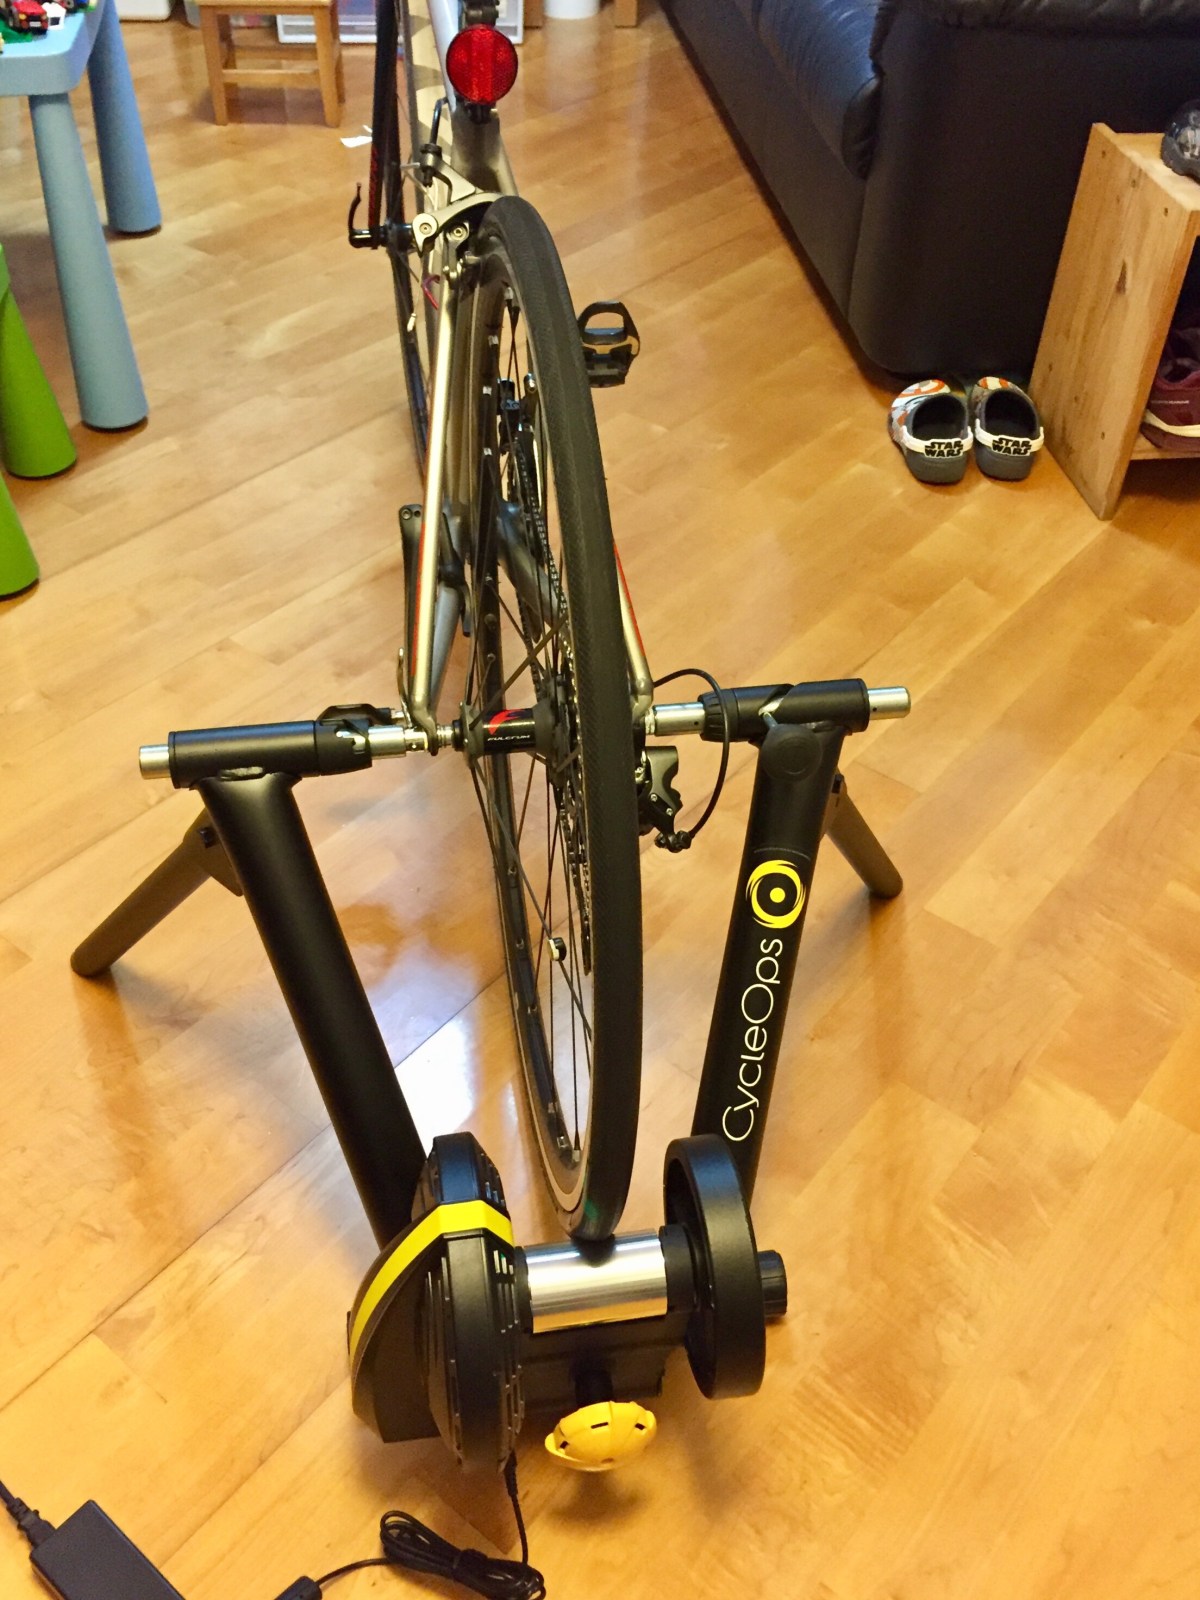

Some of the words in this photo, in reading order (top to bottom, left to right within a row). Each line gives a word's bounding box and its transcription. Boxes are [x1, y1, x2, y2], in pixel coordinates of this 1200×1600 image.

[925, 441, 962, 450] STAR
[992, 437, 1030, 447] STAR
[925, 446, 963, 457] WARS
[992, 444, 1031, 455] WARS
[722, 938, 783, 1141] CycleOps
